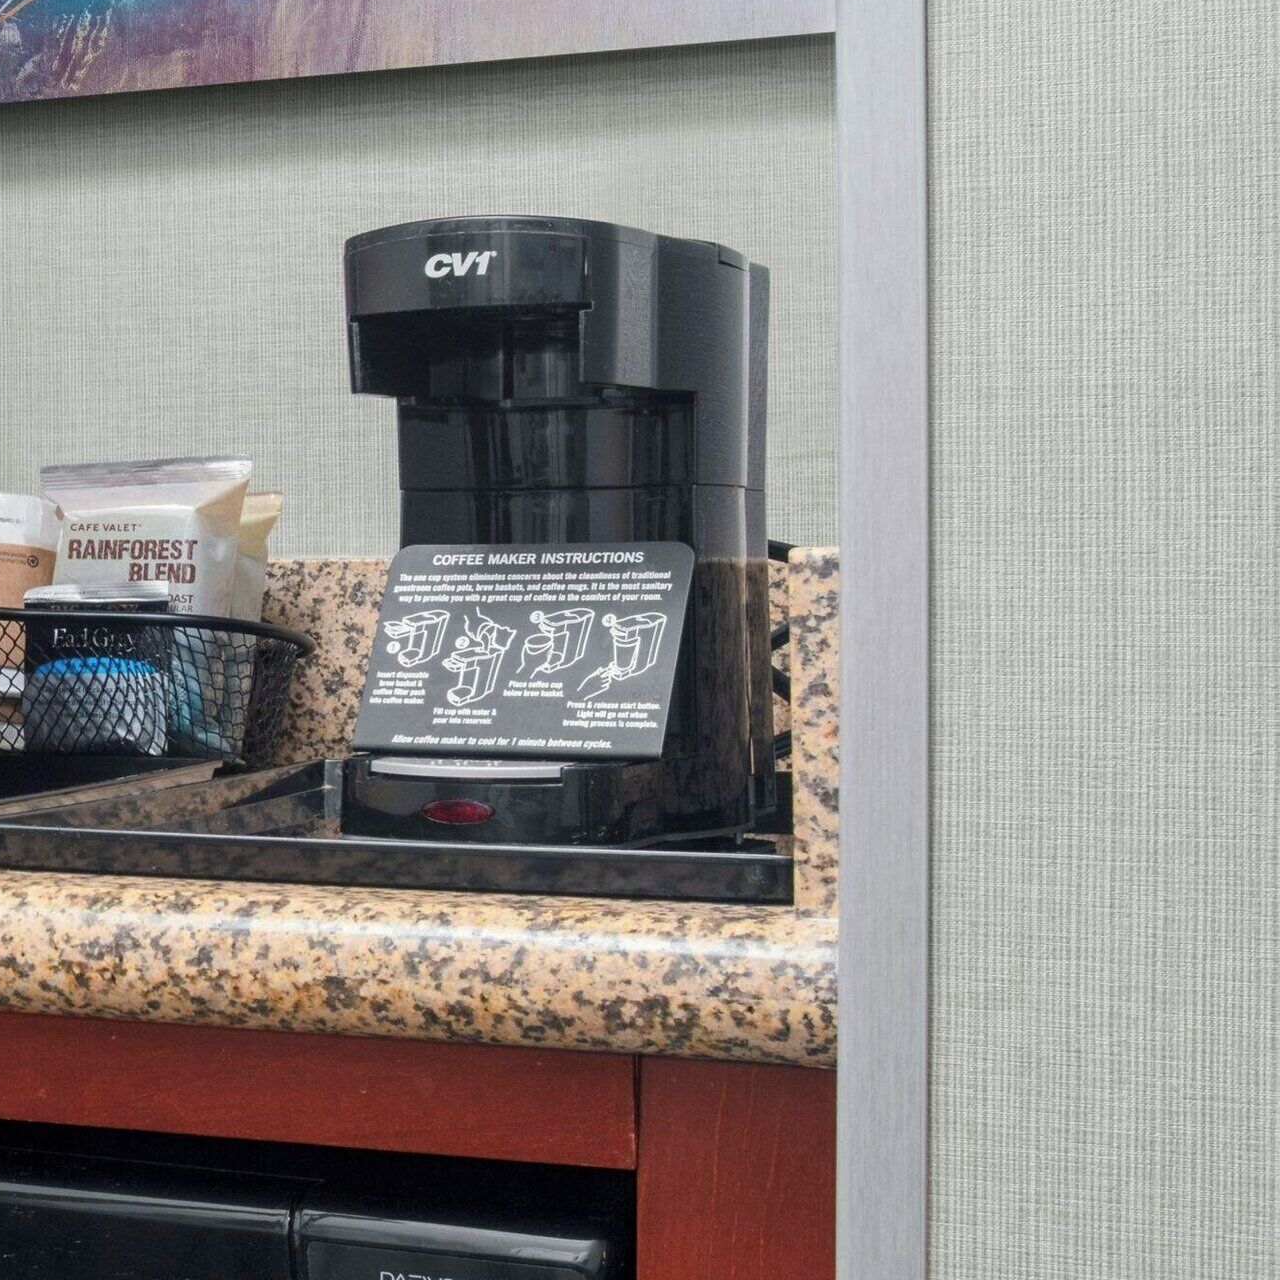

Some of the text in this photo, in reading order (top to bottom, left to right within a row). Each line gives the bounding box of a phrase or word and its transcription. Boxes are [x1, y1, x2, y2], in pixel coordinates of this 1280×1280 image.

[70, 523, 137, 532] CAFE VALET
[68, 539, 198, 560] RAINFOREST
[433, 552, 644, 565] COFFEE MAKER INSTRUCTIONS
[129, 563, 196, 584] BLEND
[428, 574, 441, 582] cup
[442, 574, 468, 582] system
[469, 573, 505, 581] eliminates
[507, 573, 541, 581] concerns
[542, 572, 564, 580] about
[565, 572, 577, 580] the
[579, 572, 620, 580] cleanliness
[631, 571, 671, 579] traditional
[394, 584, 431, 593] guestroom
[495, 583, 525, 592] baskets,
[567, 583, 589, 592] mugs.
[607, 582, 620, 590] the
[621, 582, 640, 590] most
[641, 582, 673, 591] sanitary
[399, 595, 412, 603] way
[414, 594, 421, 602] to
[422, 594, 449, 603] provide
[451, 595, 463, 603] you
[487, 594, 507, 602] great
[508, 594, 523, 602] cup
[524, 593, 532, 601] of
[533, 593, 558, 601] coffee
[621, 594, 639, 602] your
[392, 734, 413, 743] Allow
[414, 735, 439, 744] coffee
[440, 736, 467, 744] maker
[468, 737, 477, 745] to
[478, 737, 496, 745] cool
[497, 737, 511, 746] for
[518, 738, 546, 746] minute
[547, 738, 582, 747] between
[583, 739, 612, 749] cycles.
